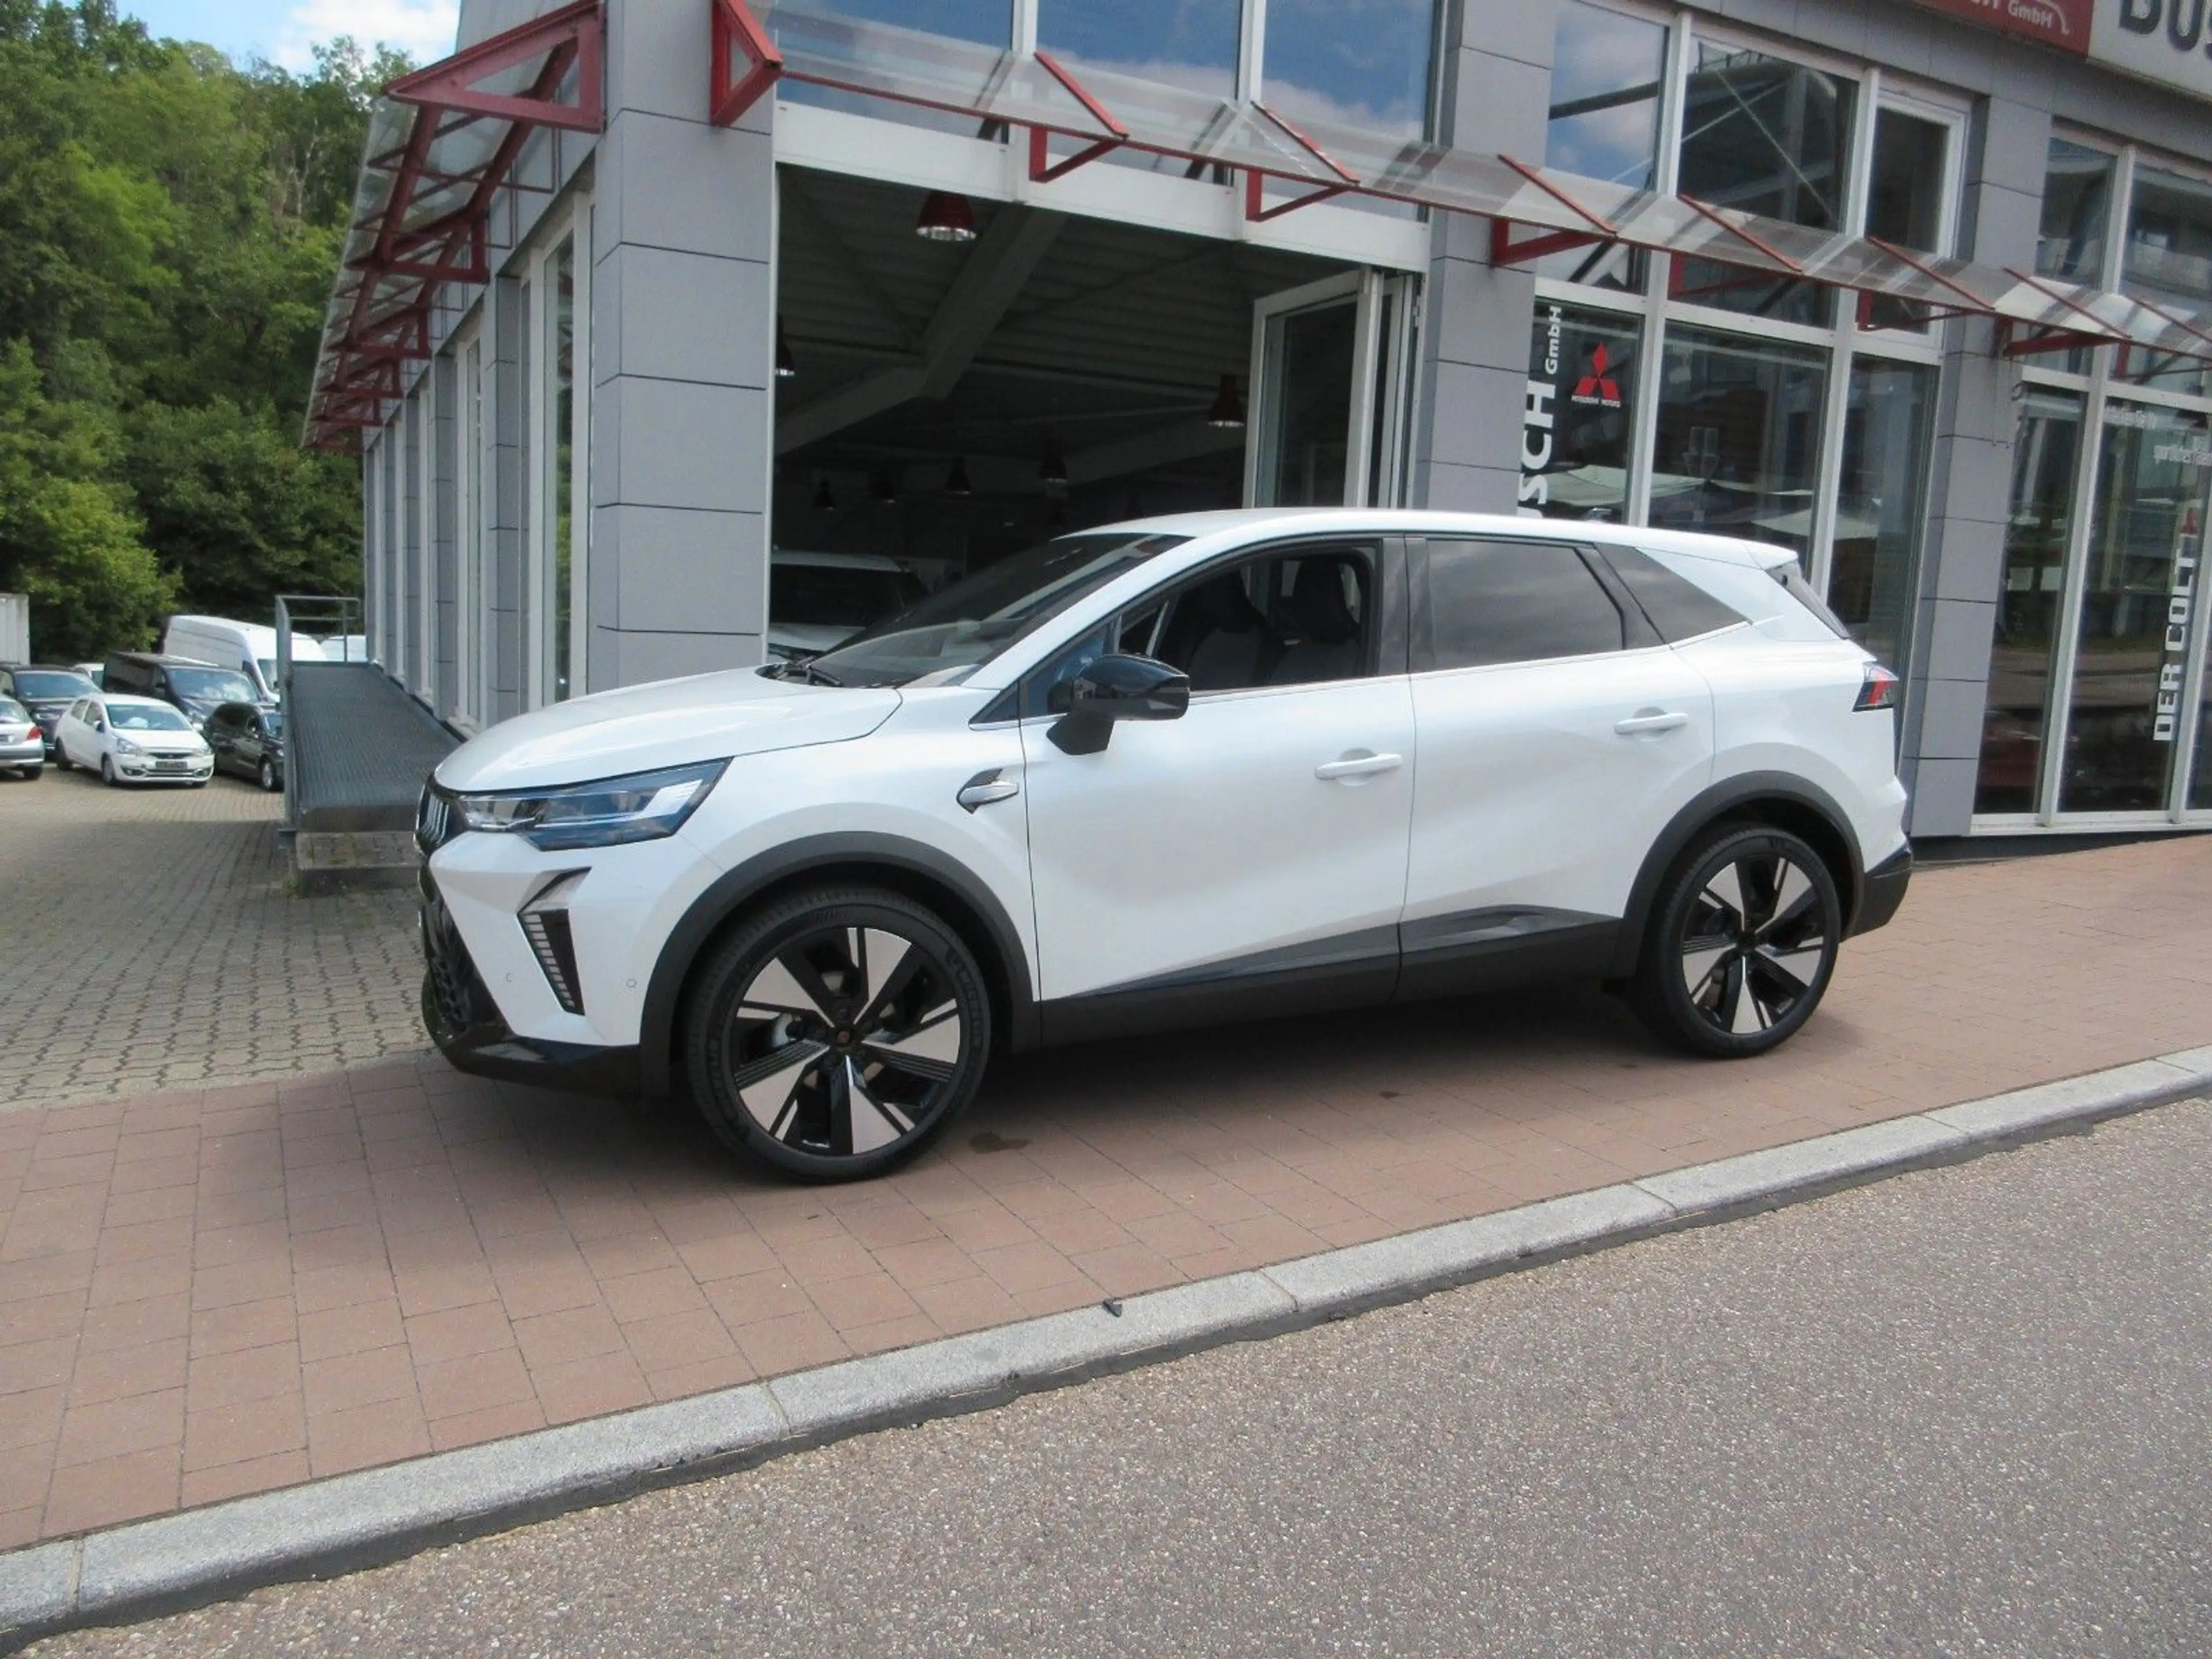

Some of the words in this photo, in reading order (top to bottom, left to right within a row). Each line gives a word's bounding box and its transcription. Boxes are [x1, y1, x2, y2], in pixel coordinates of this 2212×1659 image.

[2008, 0, 2053, 29] GmbH
[1545, 305, 1562, 375] GmbH
[2165, 548, 2196, 651] COLT
[2153, 663, 2182, 741] DER
